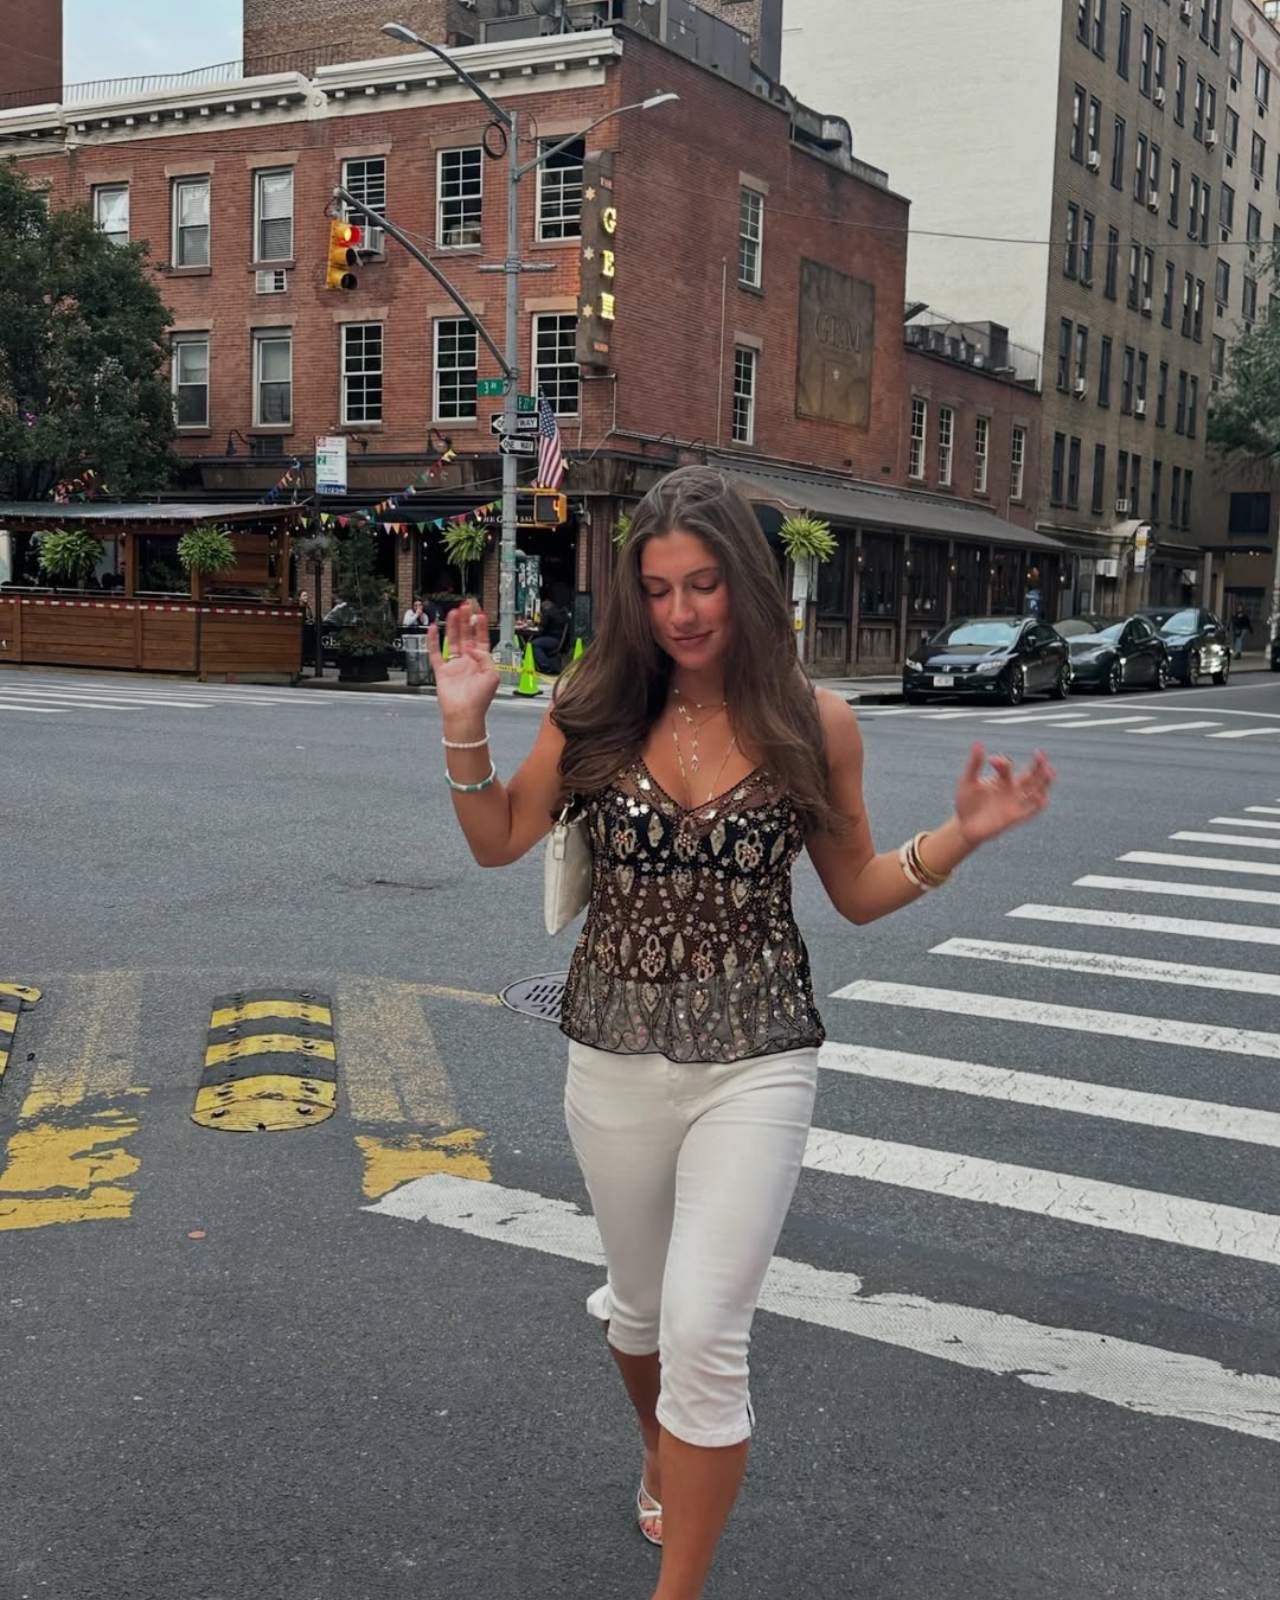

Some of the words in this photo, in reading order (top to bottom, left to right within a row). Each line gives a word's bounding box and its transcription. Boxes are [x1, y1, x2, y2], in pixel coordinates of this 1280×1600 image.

[484, 382, 490, 395] 3
[518, 397, 523, 410] E
[519, 419, 537, 428] WAY
[503, 440, 516, 450] ONE
[521, 442, 534, 451] WAY
